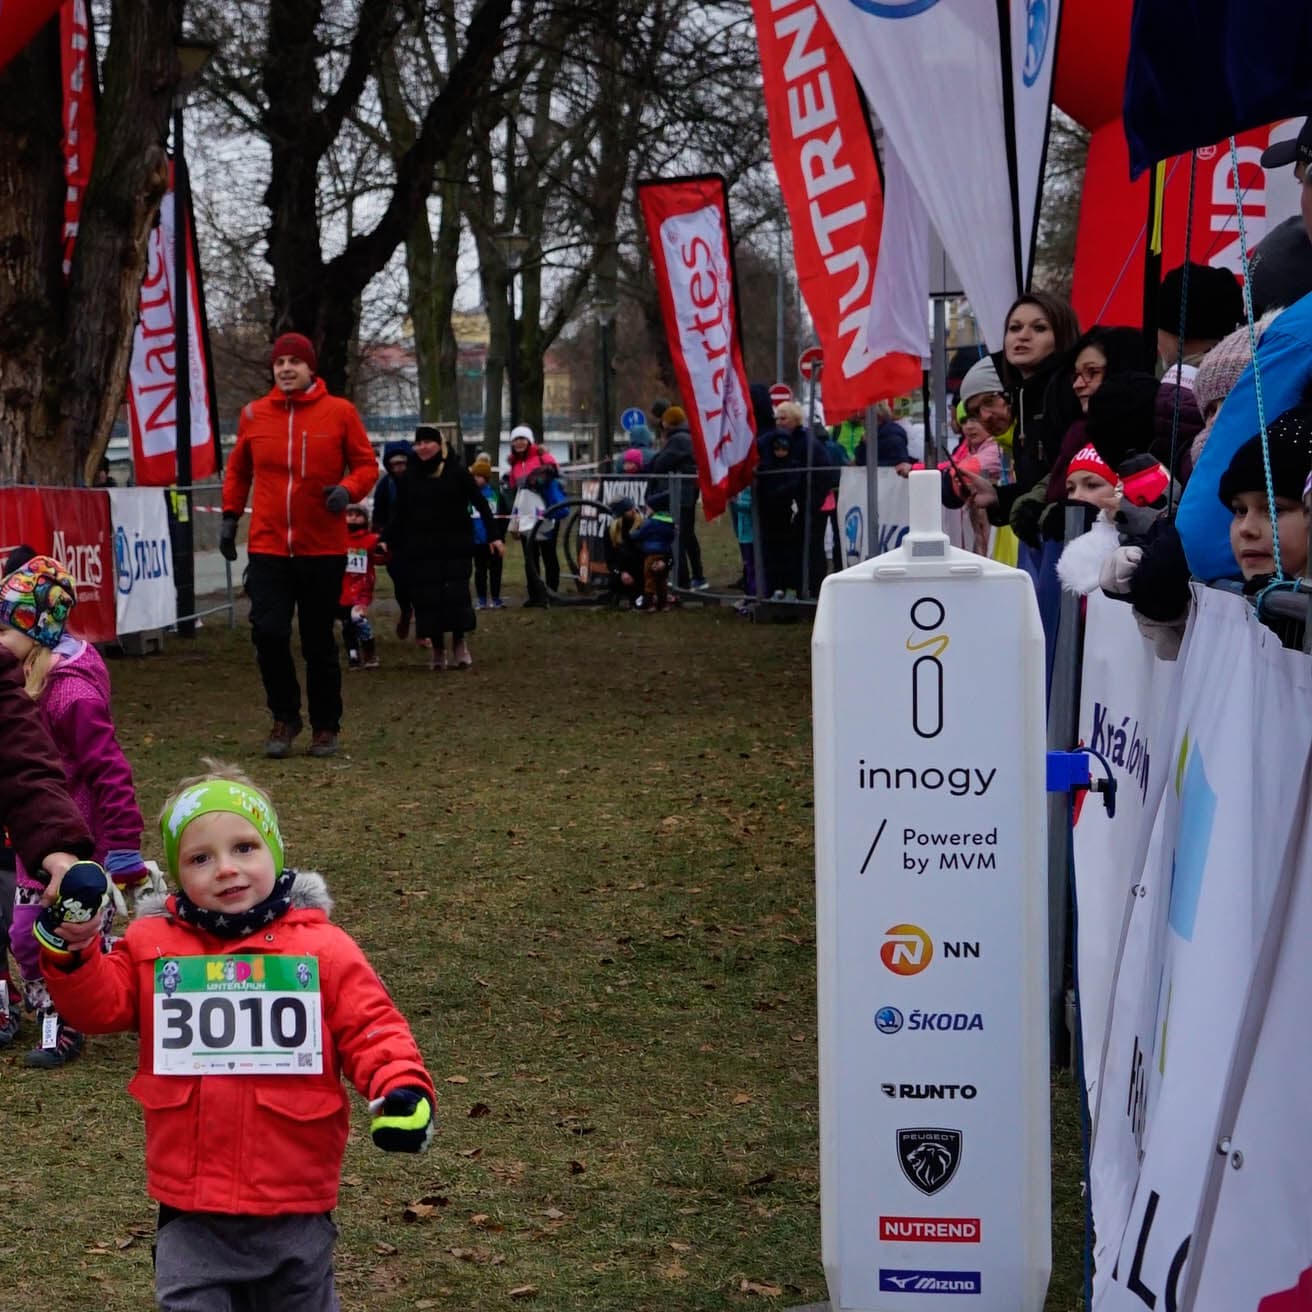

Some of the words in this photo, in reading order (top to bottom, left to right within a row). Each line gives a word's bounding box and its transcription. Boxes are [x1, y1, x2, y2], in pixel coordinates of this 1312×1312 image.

[138, 226, 178, 433] Nart
[859, 759, 997, 796] innogy
[903, 826, 998, 846] Powered
[903, 851, 930, 875] by
[938, 852, 997, 870] MVM
[943, 941, 980, 959] NN
[161, 996, 308, 1050] 3010
[907, 1009, 985, 1031] ŠKODA
[899, 1084, 978, 1100] RUNTO
[902, 1133, 956, 1141] PEUGEOT
[884, 1221, 977, 1238] NUTREND
